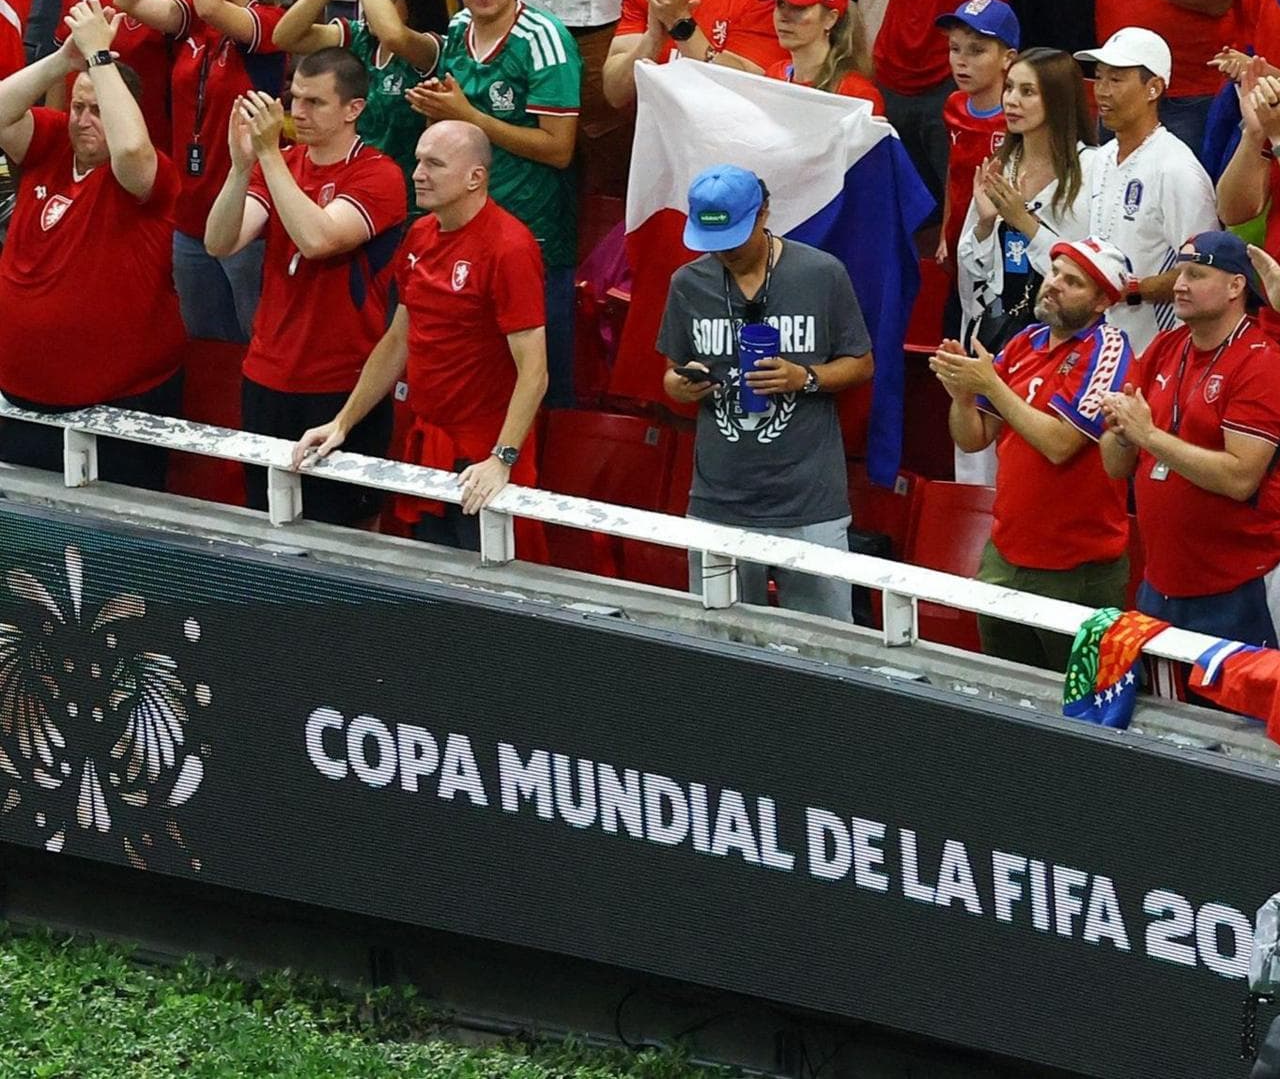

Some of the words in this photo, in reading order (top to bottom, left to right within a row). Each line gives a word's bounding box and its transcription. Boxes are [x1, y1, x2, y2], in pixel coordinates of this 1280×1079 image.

[693, 315, 743, 358] SOUT
[763, 315, 816, 354] REA
[304, 705, 490, 807] COPA
[497, 741, 796, 871] MUNDIAL
[805, 806, 890, 893] DE
[899, 827, 983, 915] LA
[991, 850, 1131, 952] FIFA
